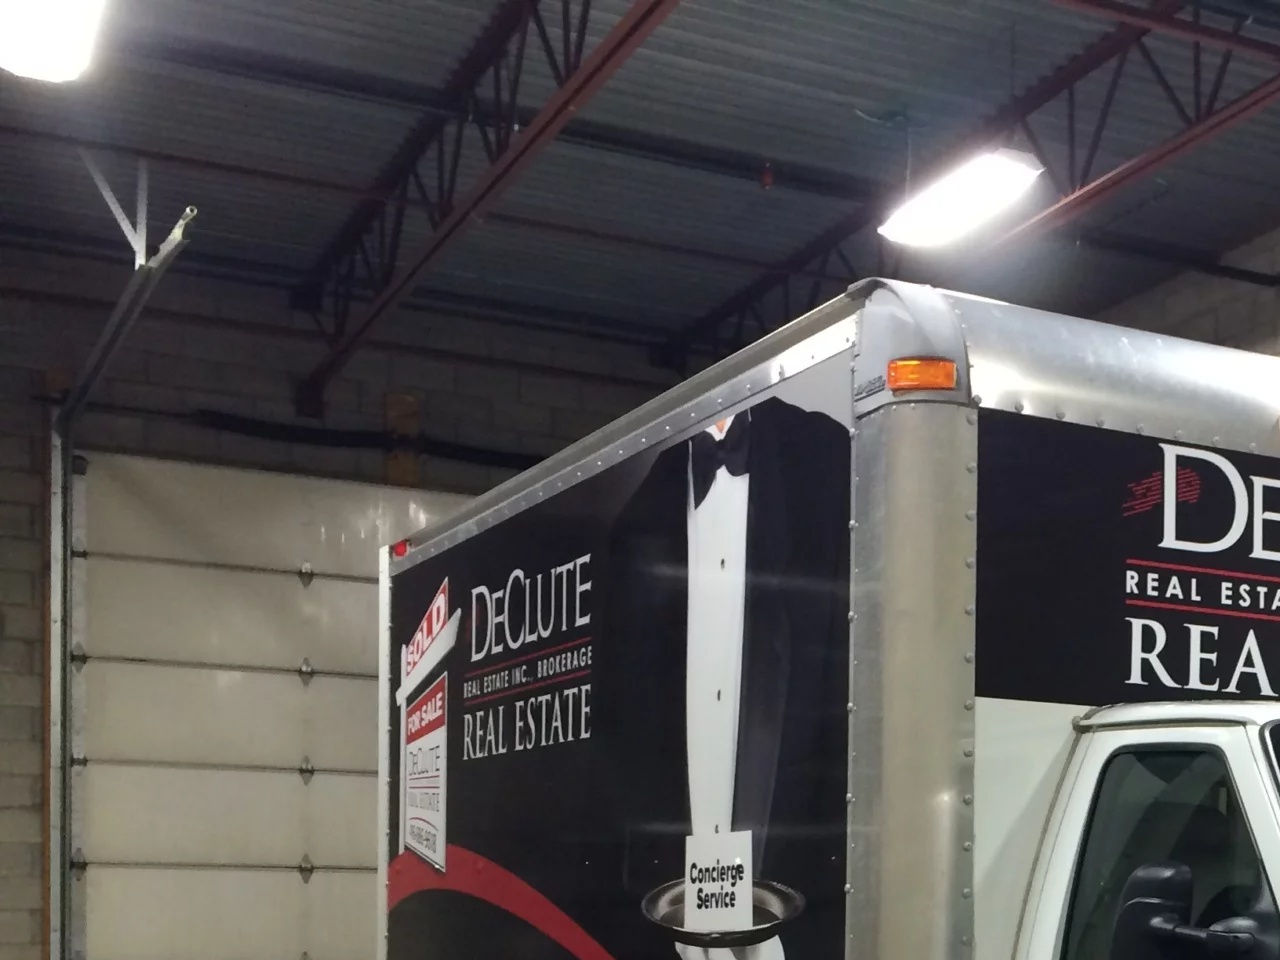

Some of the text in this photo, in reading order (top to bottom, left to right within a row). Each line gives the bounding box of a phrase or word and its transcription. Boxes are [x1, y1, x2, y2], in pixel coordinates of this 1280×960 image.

[1125, 570, 1202, 601] REAL
[406, 593, 446, 672] SOLD
[464, 679, 480, 698] REAL
[484, 670, 509, 693] ESTATE
[537, 646, 592, 678] BROKERAGE
[407, 691, 444, 736] FOR SALE
[463, 684, 592, 760] REAL ESTATE
[690, 859, 744, 887] Concierge
[697, 885, 736, 909] Service
